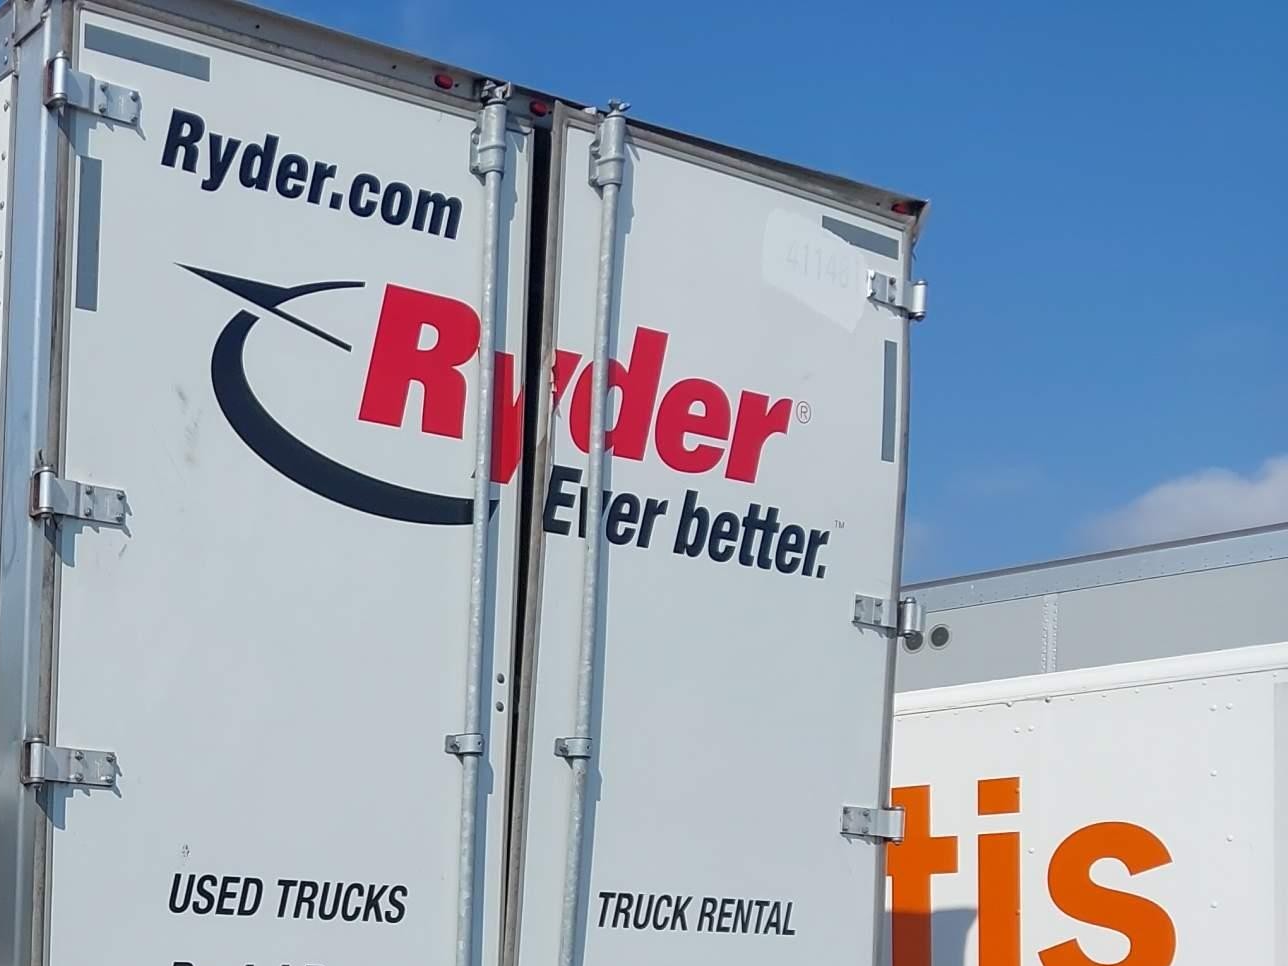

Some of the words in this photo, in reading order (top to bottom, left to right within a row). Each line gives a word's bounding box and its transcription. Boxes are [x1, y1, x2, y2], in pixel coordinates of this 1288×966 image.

[161, 107, 463, 241] Ryder.com
[673, 489, 831, 580] better.
[168, 872, 264, 916] USED
[276, 879, 409, 924] TRUCKS
[598, 891, 694, 931] TRUCK
[696, 897, 797, 936] RENTAL
